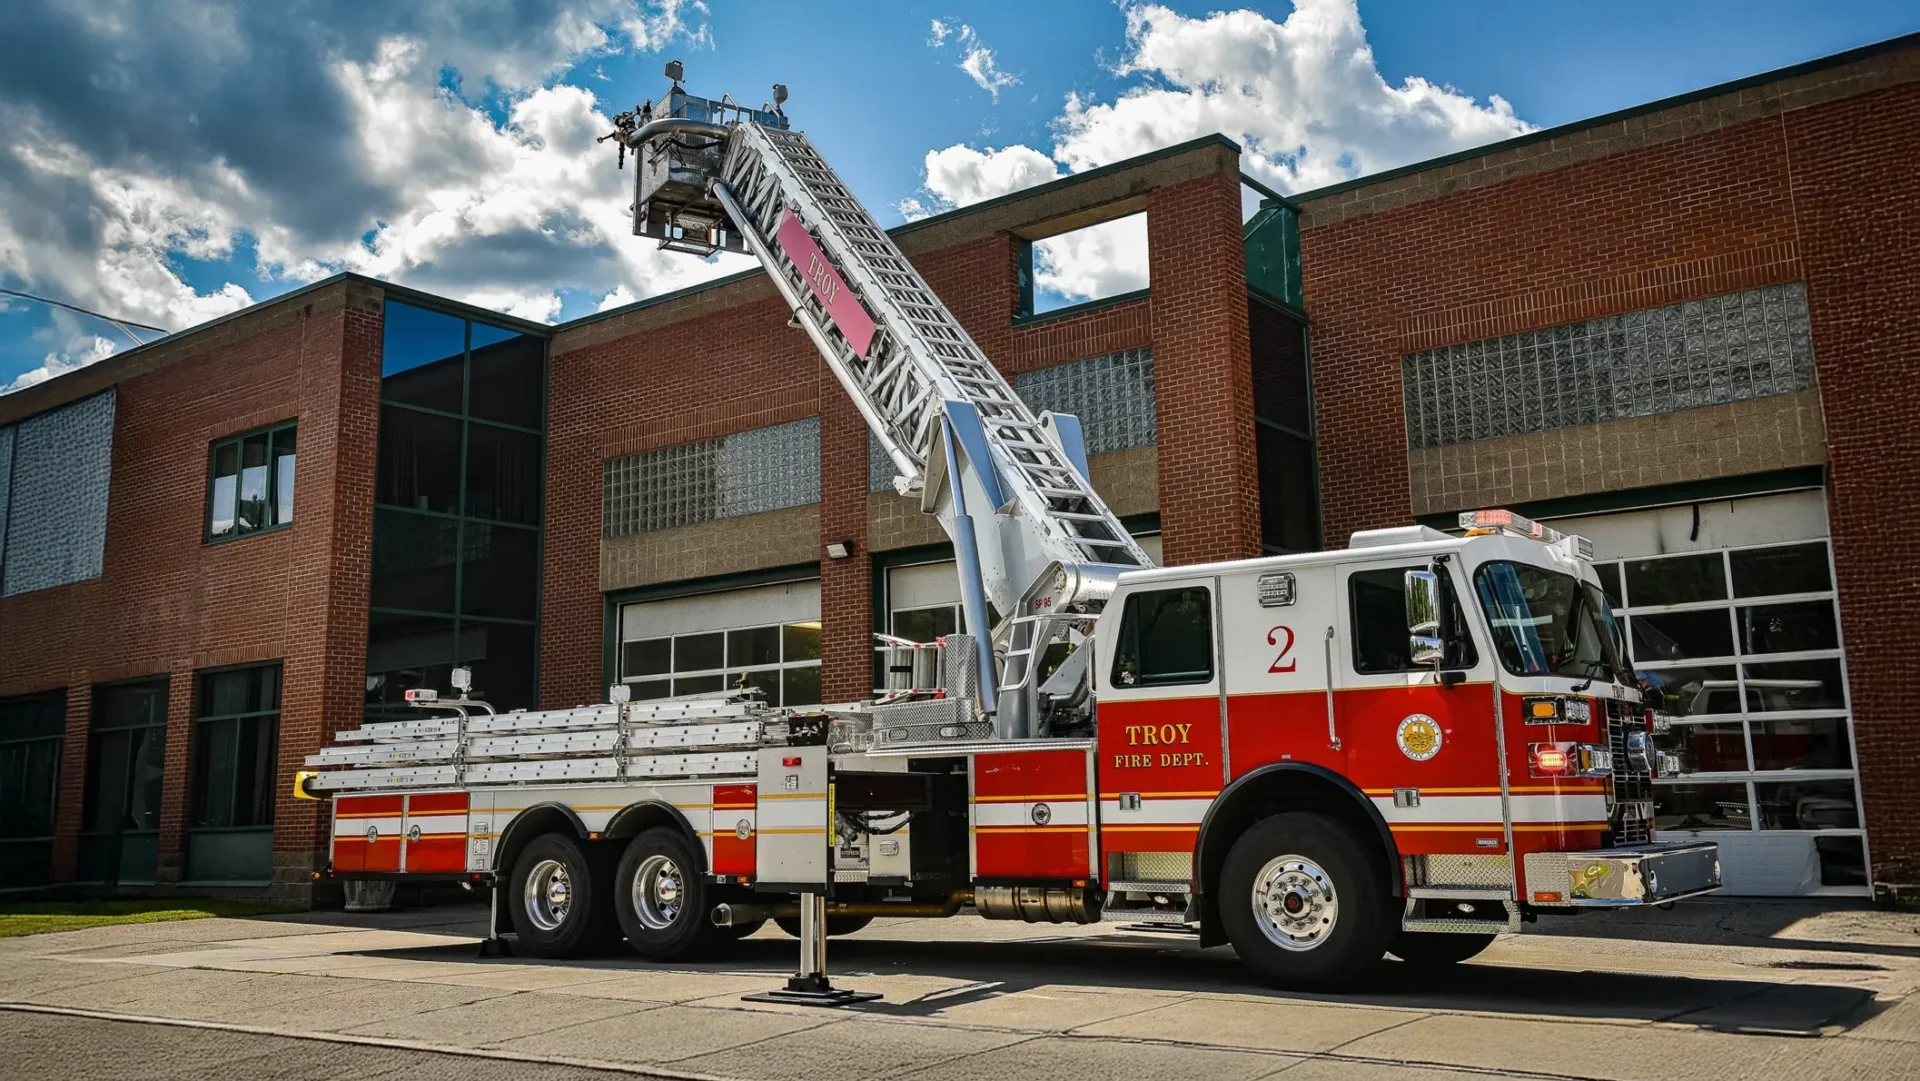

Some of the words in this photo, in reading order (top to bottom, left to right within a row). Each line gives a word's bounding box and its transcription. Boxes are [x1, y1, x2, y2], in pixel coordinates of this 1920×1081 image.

[808, 252, 840, 305] TROY
[1034, 599, 1043, 609] SP
[1044, 597, 1051, 608] 95
[1267, 625, 1296, 674] 2
[1400, 715, 1421, 730] CITY
[1125, 723, 1192, 746] TROY
[1114, 753, 1152, 768] FIRE
[1160, 752, 1209, 767] DEPT.
